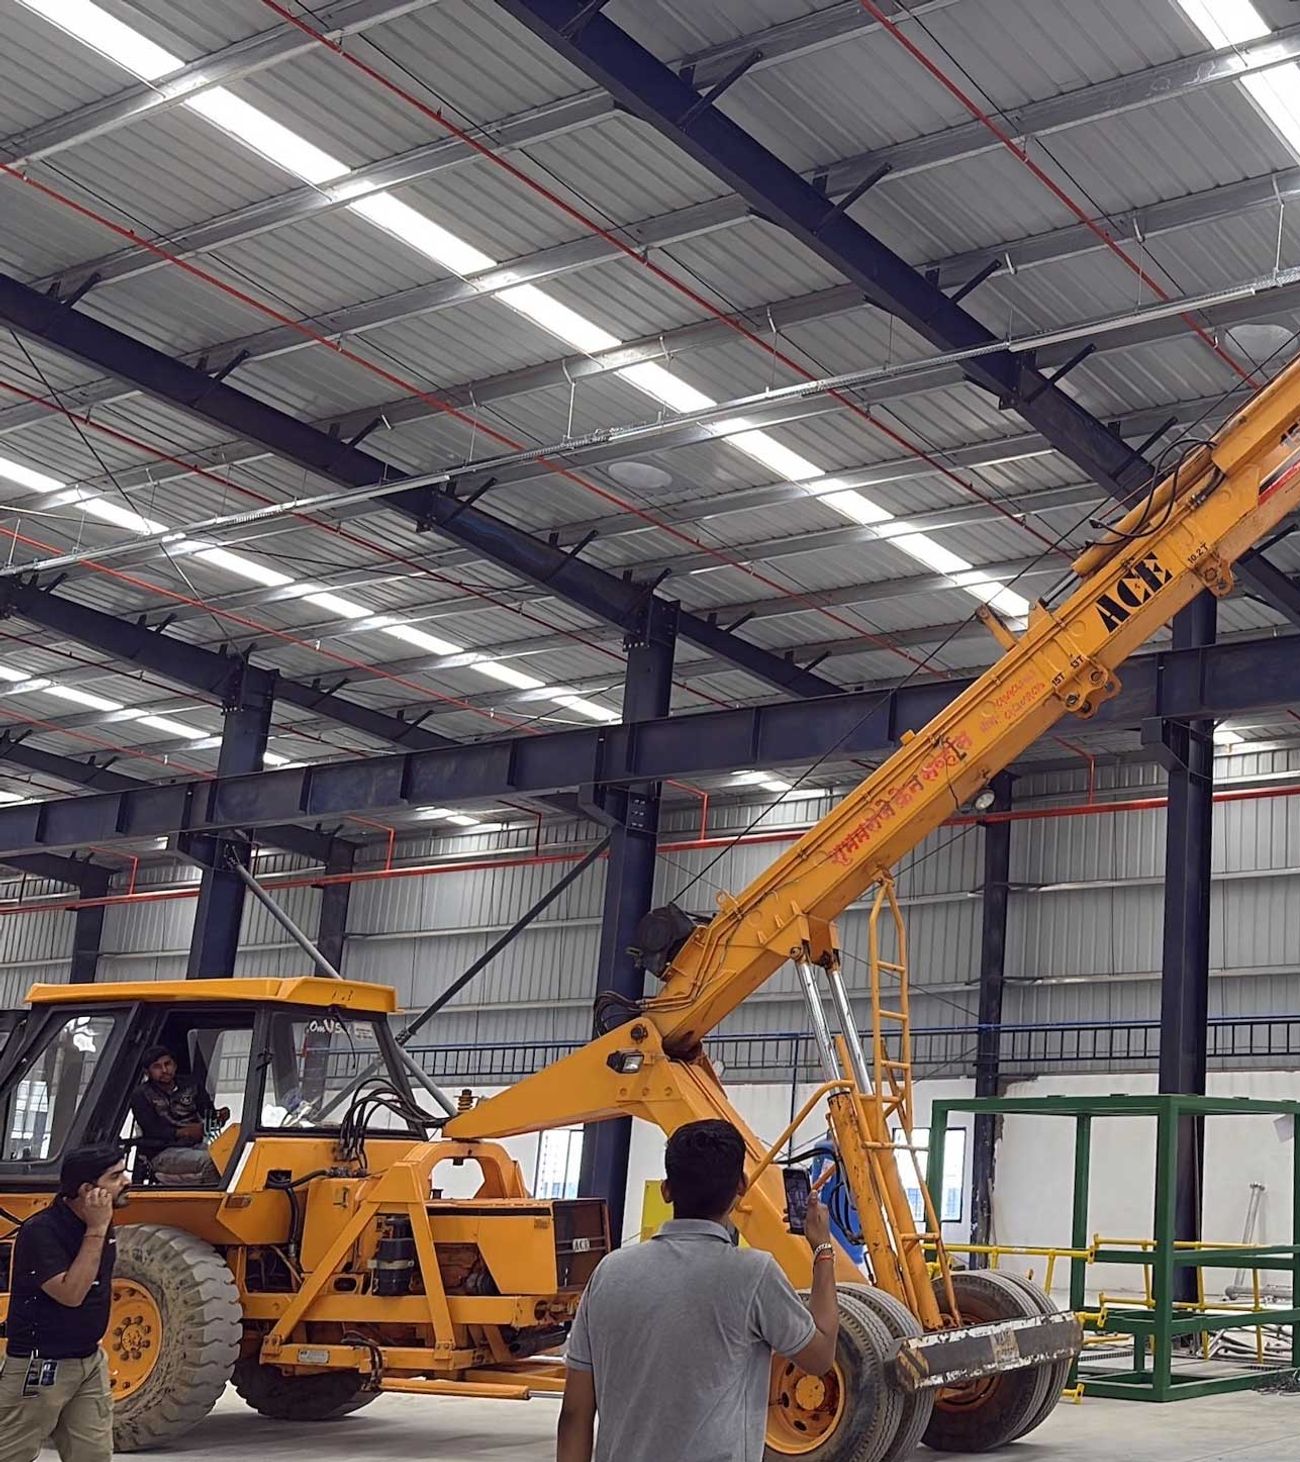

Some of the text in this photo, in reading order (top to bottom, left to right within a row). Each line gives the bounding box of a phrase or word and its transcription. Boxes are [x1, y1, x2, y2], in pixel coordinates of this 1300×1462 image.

[1096, 551, 1174, 633] ACE
[1070, 655, 1084, 669] 13T
[1051, 672, 1065, 686] 15T
